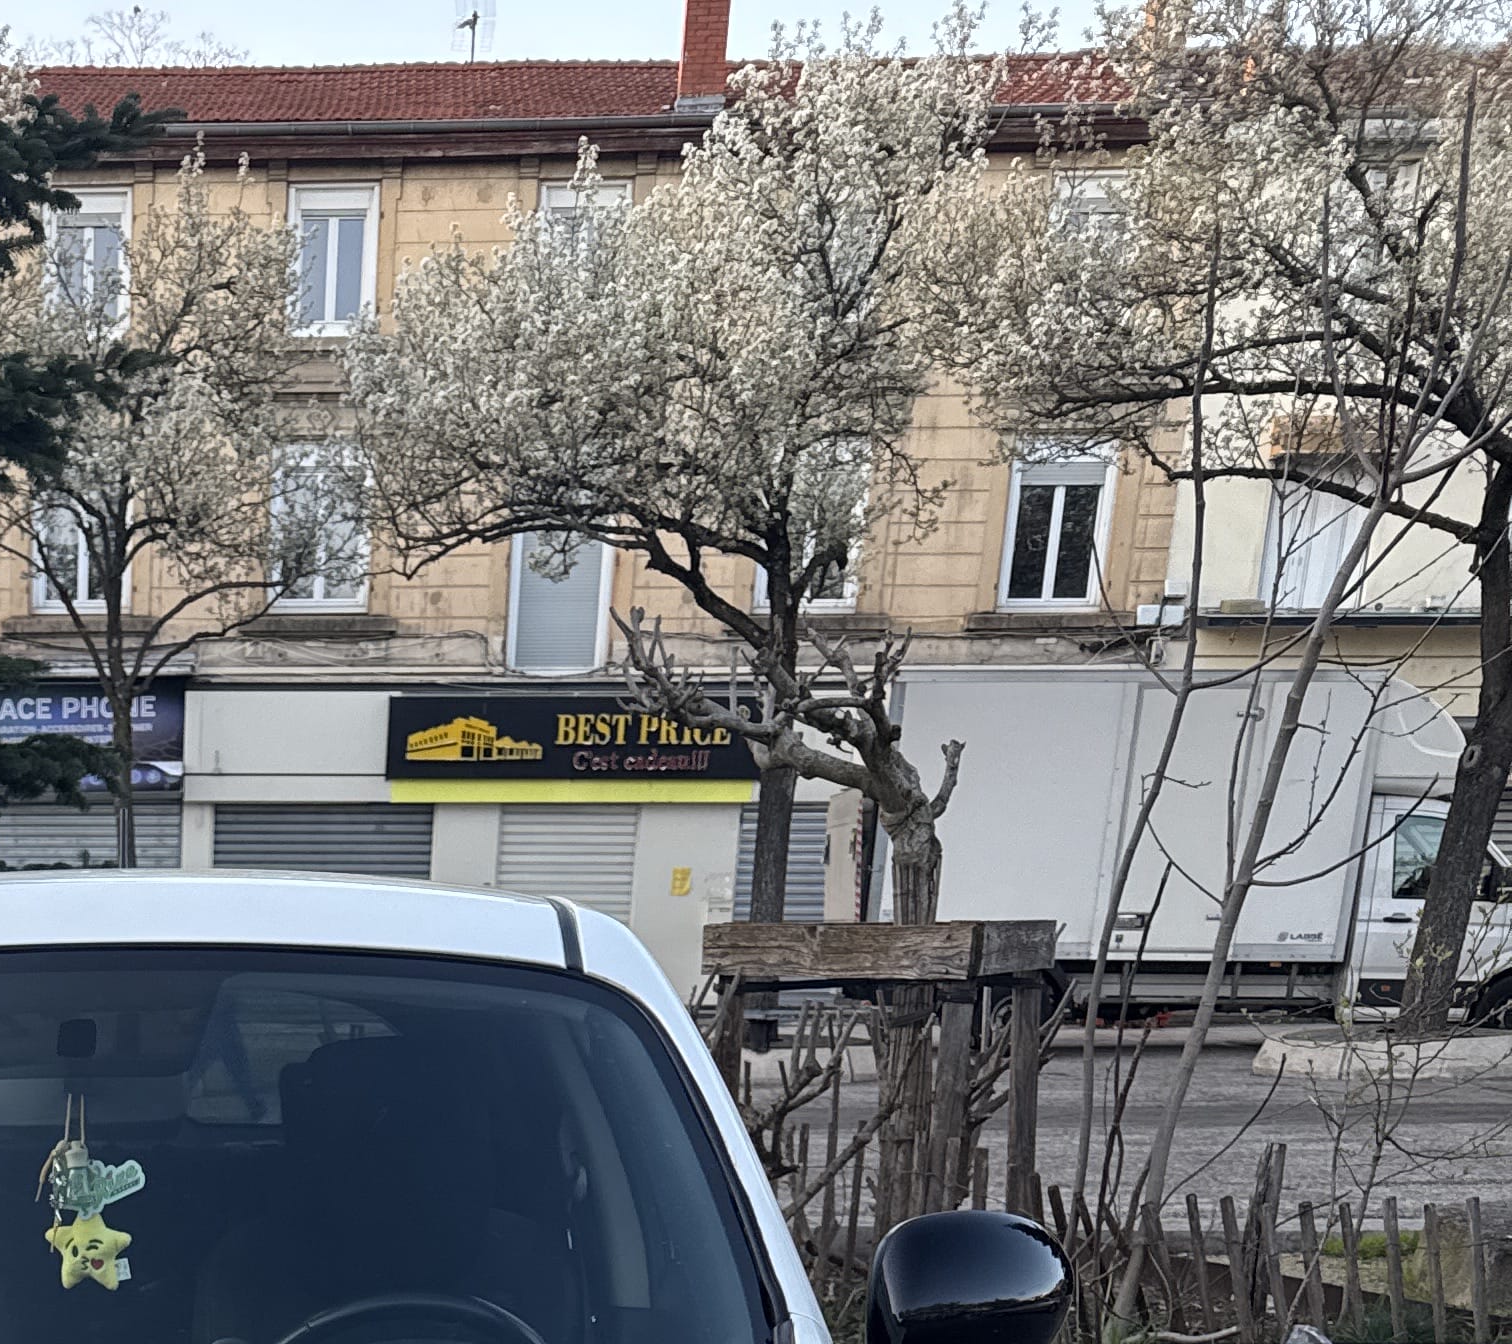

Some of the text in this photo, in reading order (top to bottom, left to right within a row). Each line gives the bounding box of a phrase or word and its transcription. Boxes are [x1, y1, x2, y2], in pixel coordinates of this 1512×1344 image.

[554, 713, 732, 746] BEST PRICE
[572, 749, 620, 772] C'est
